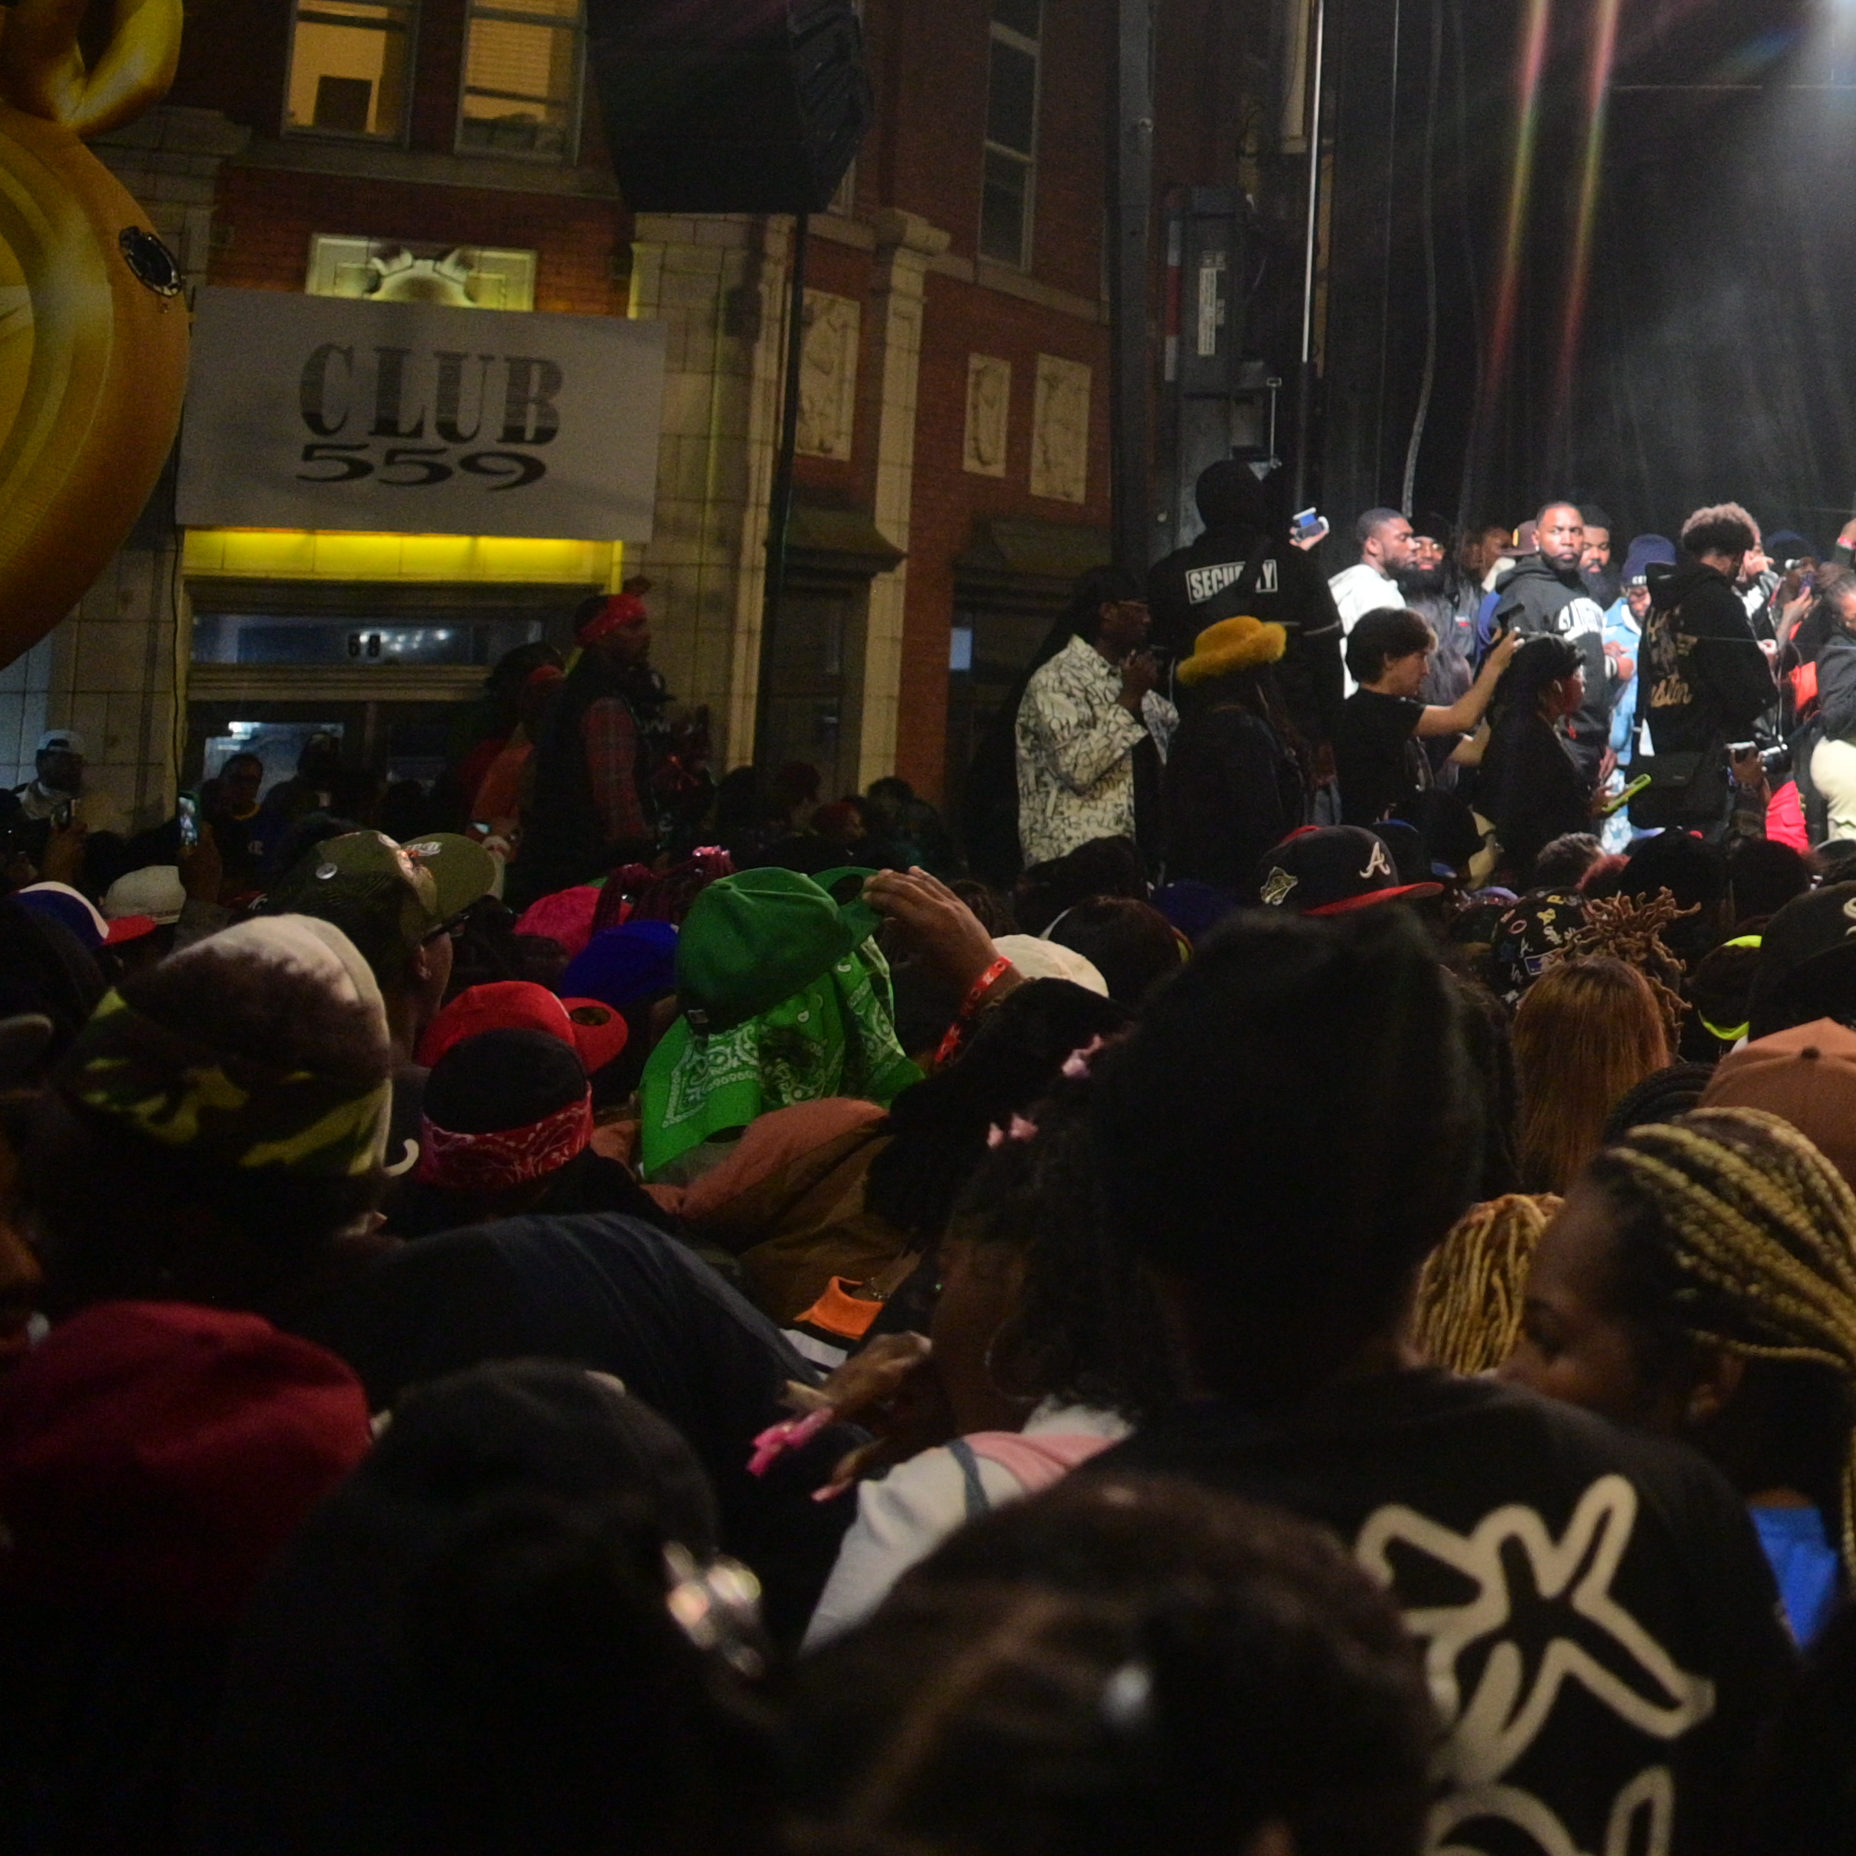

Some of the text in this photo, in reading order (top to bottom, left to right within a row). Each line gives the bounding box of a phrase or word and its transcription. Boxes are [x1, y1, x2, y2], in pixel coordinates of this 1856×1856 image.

[299, 343, 566, 446] CLUB
[295, 443, 547, 492] 559
[1189, 561, 1275, 600] SECUY
[1359, 841, 1392, 880] A
